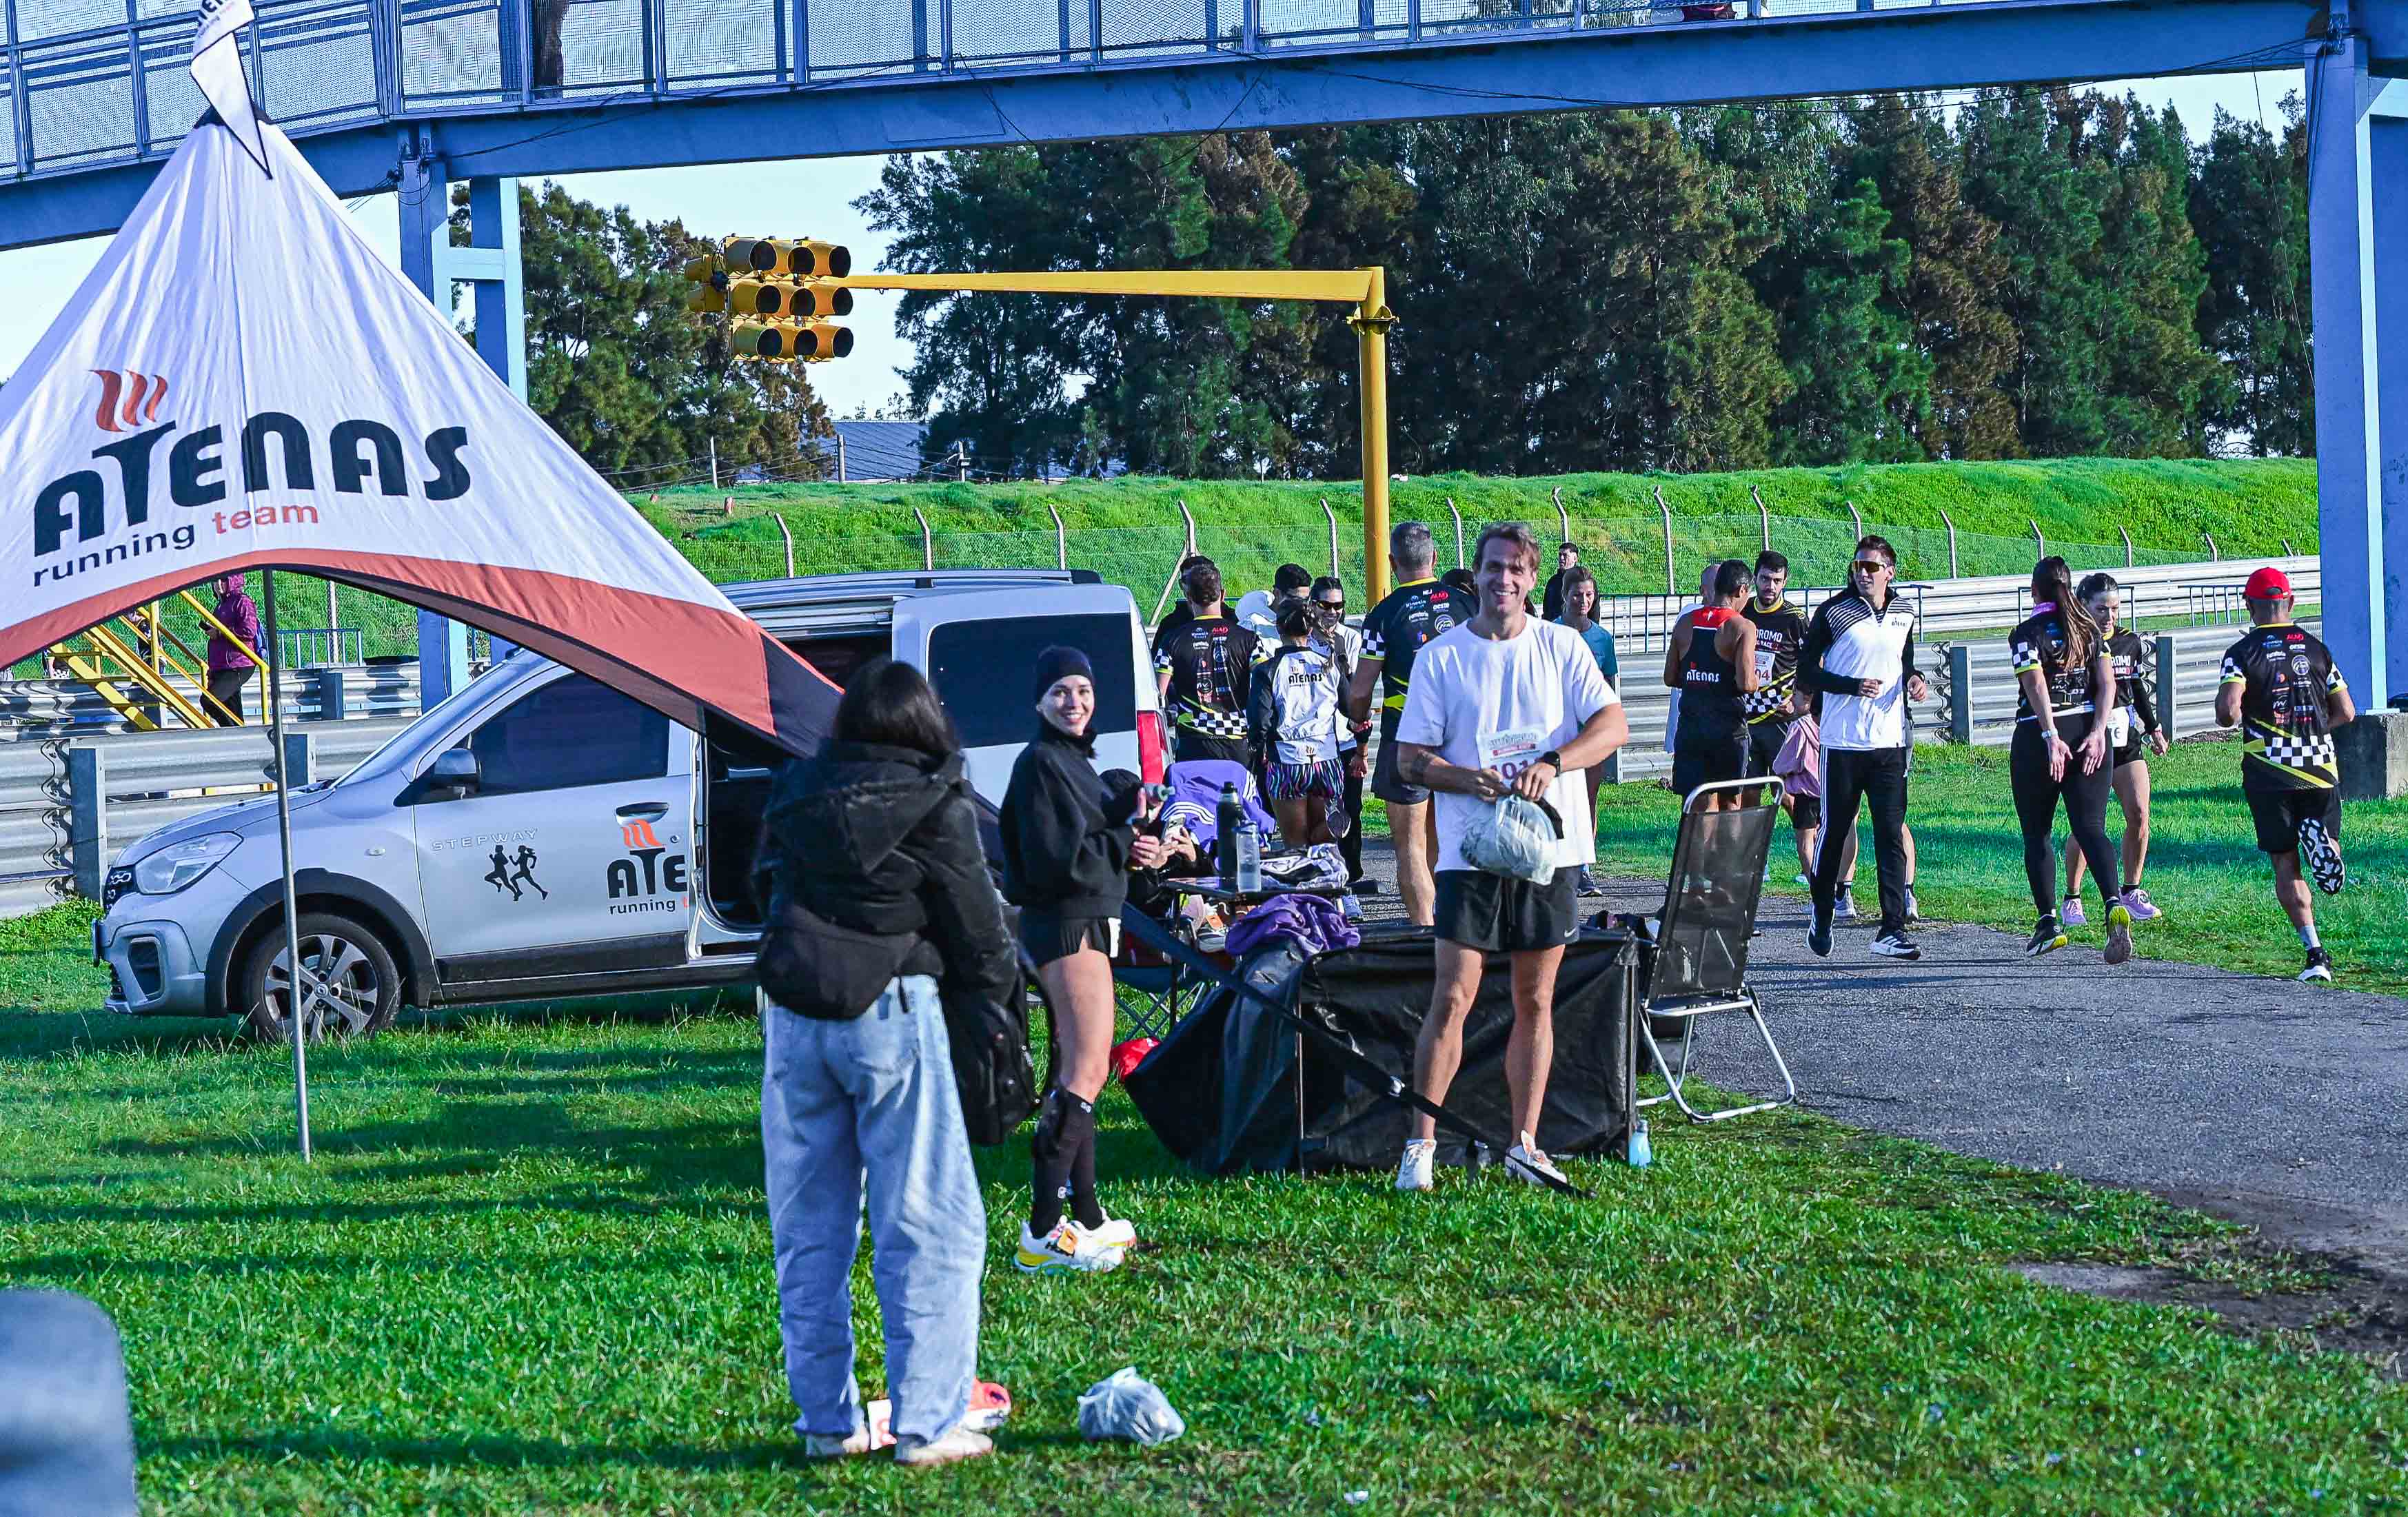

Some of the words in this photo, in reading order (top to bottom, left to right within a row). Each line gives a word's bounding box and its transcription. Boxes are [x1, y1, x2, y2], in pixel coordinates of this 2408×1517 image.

[34, 411, 470, 557] ATENAS
[33, 524, 195, 588] running
[212, 504, 319, 534] team
[1288, 673, 1322, 684] ATENAS
[1686, 669, 1720, 682] ATENAS
[432, 827, 538, 851] STEPWAY
[609, 899, 676, 915] running
